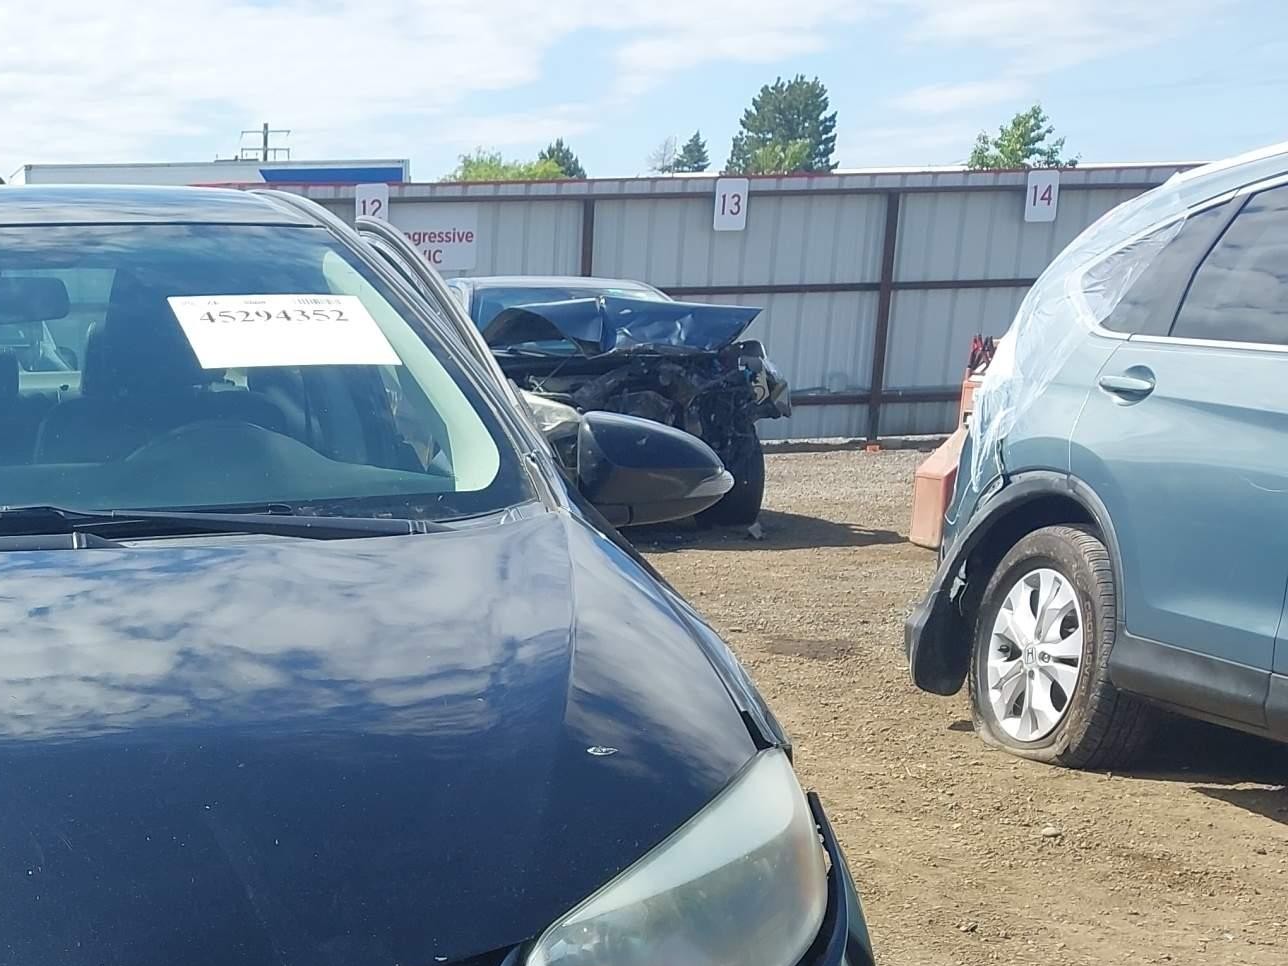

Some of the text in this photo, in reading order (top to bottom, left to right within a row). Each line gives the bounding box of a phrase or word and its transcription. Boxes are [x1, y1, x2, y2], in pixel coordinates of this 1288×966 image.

[720, 193, 742, 216] 13
[1031, 184, 1053, 207] 14
[360, 198, 383, 219] 12
[199, 308, 350, 324] 45294352
